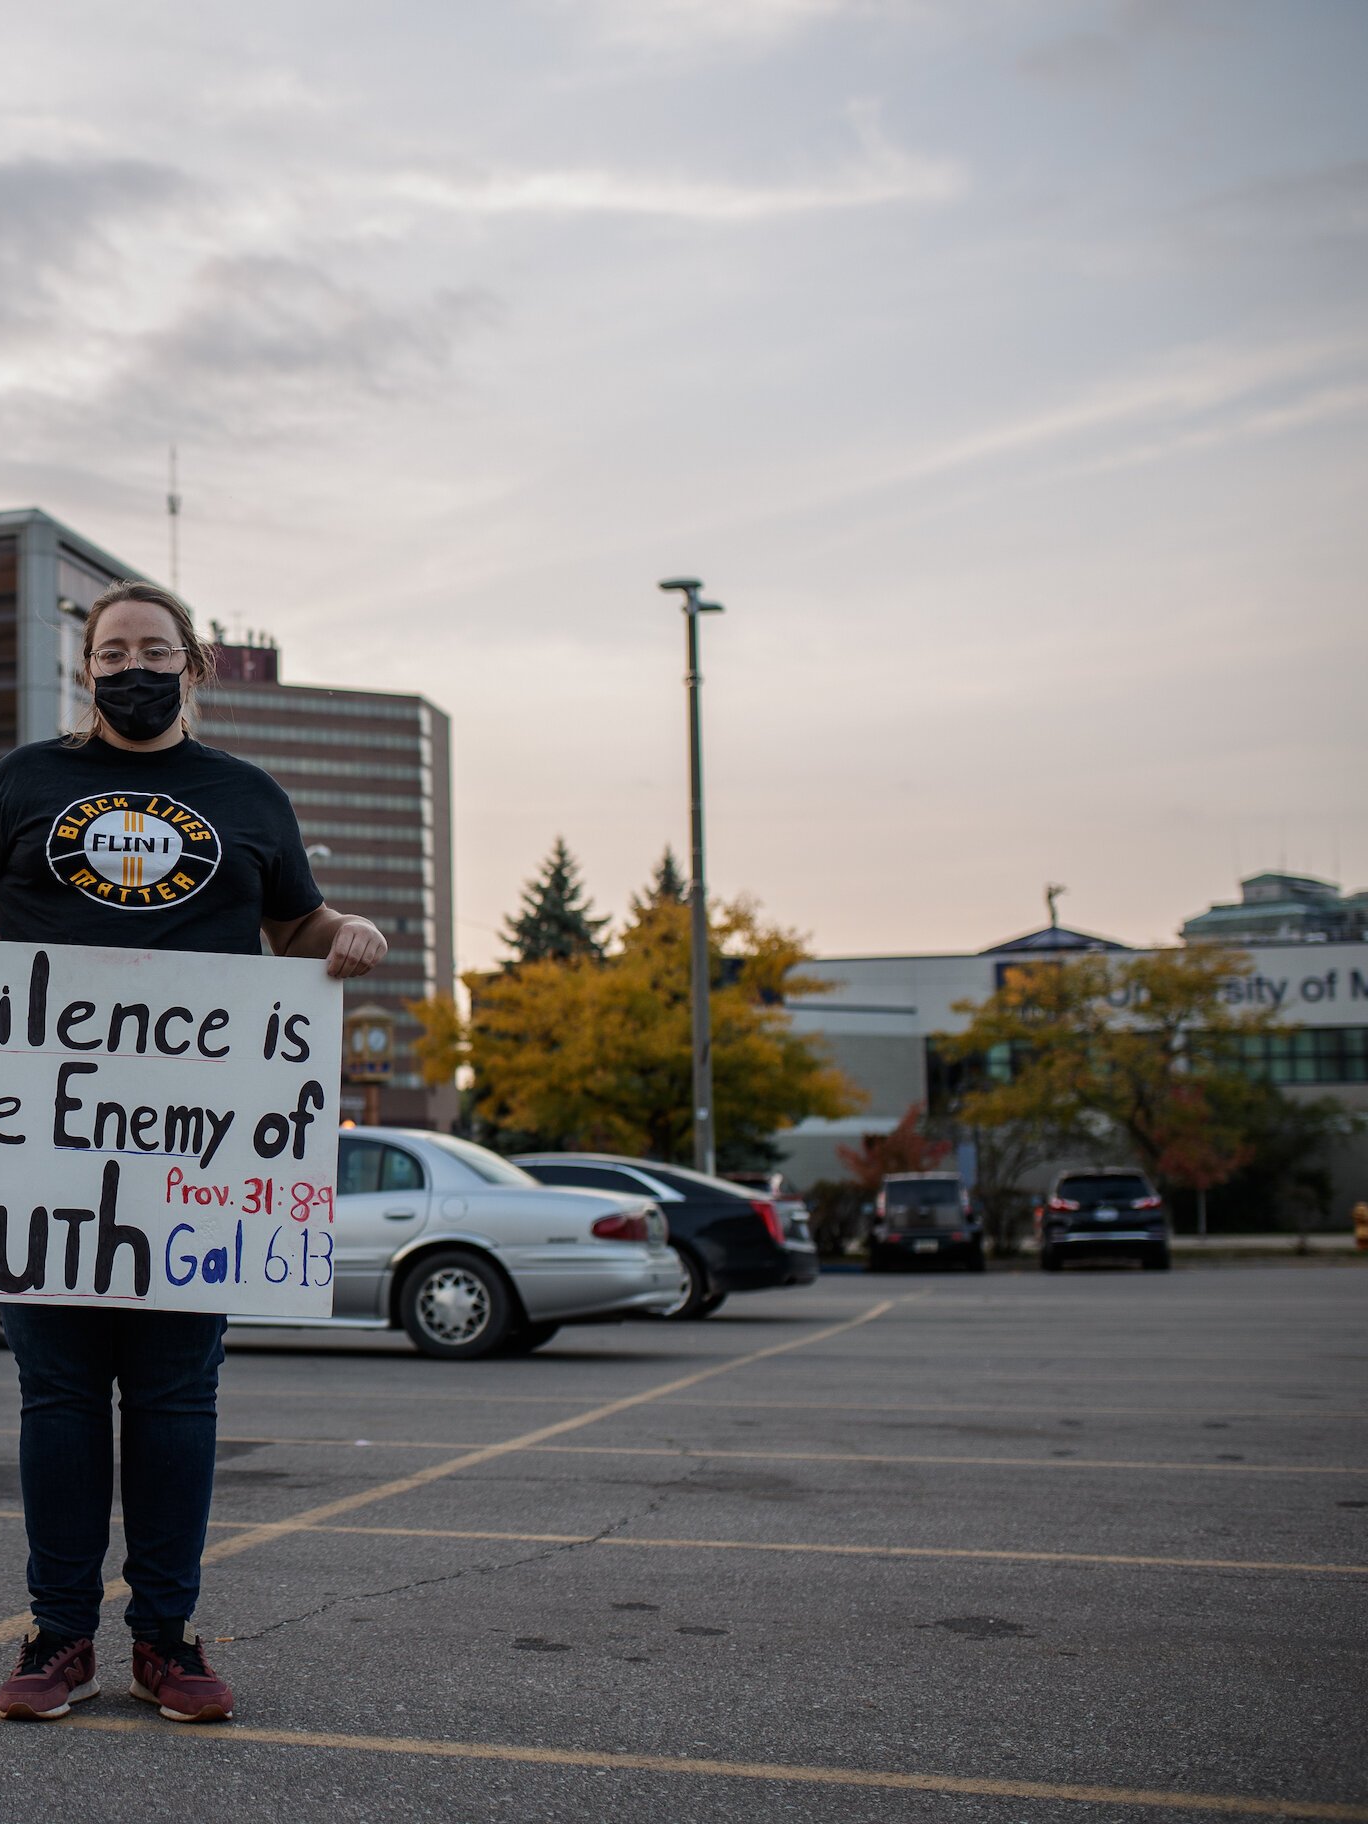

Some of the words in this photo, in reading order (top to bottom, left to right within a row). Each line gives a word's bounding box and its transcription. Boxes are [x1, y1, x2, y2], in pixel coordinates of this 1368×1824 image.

[57, 797, 129, 840] BLACK
[146, 797, 211, 841] LIVES
[92, 833, 175, 853] FLINT
[70, 868, 195, 903] MATTER
[1300, 968, 1337, 1002] of
[264, 1002, 310, 1062] is
[54, 1061, 235, 1169] Enemy
[254, 1080, 324, 1159] of
[166, 1166, 234, 1206] Prov.
[165, 1219, 247, 1287] Gal.
